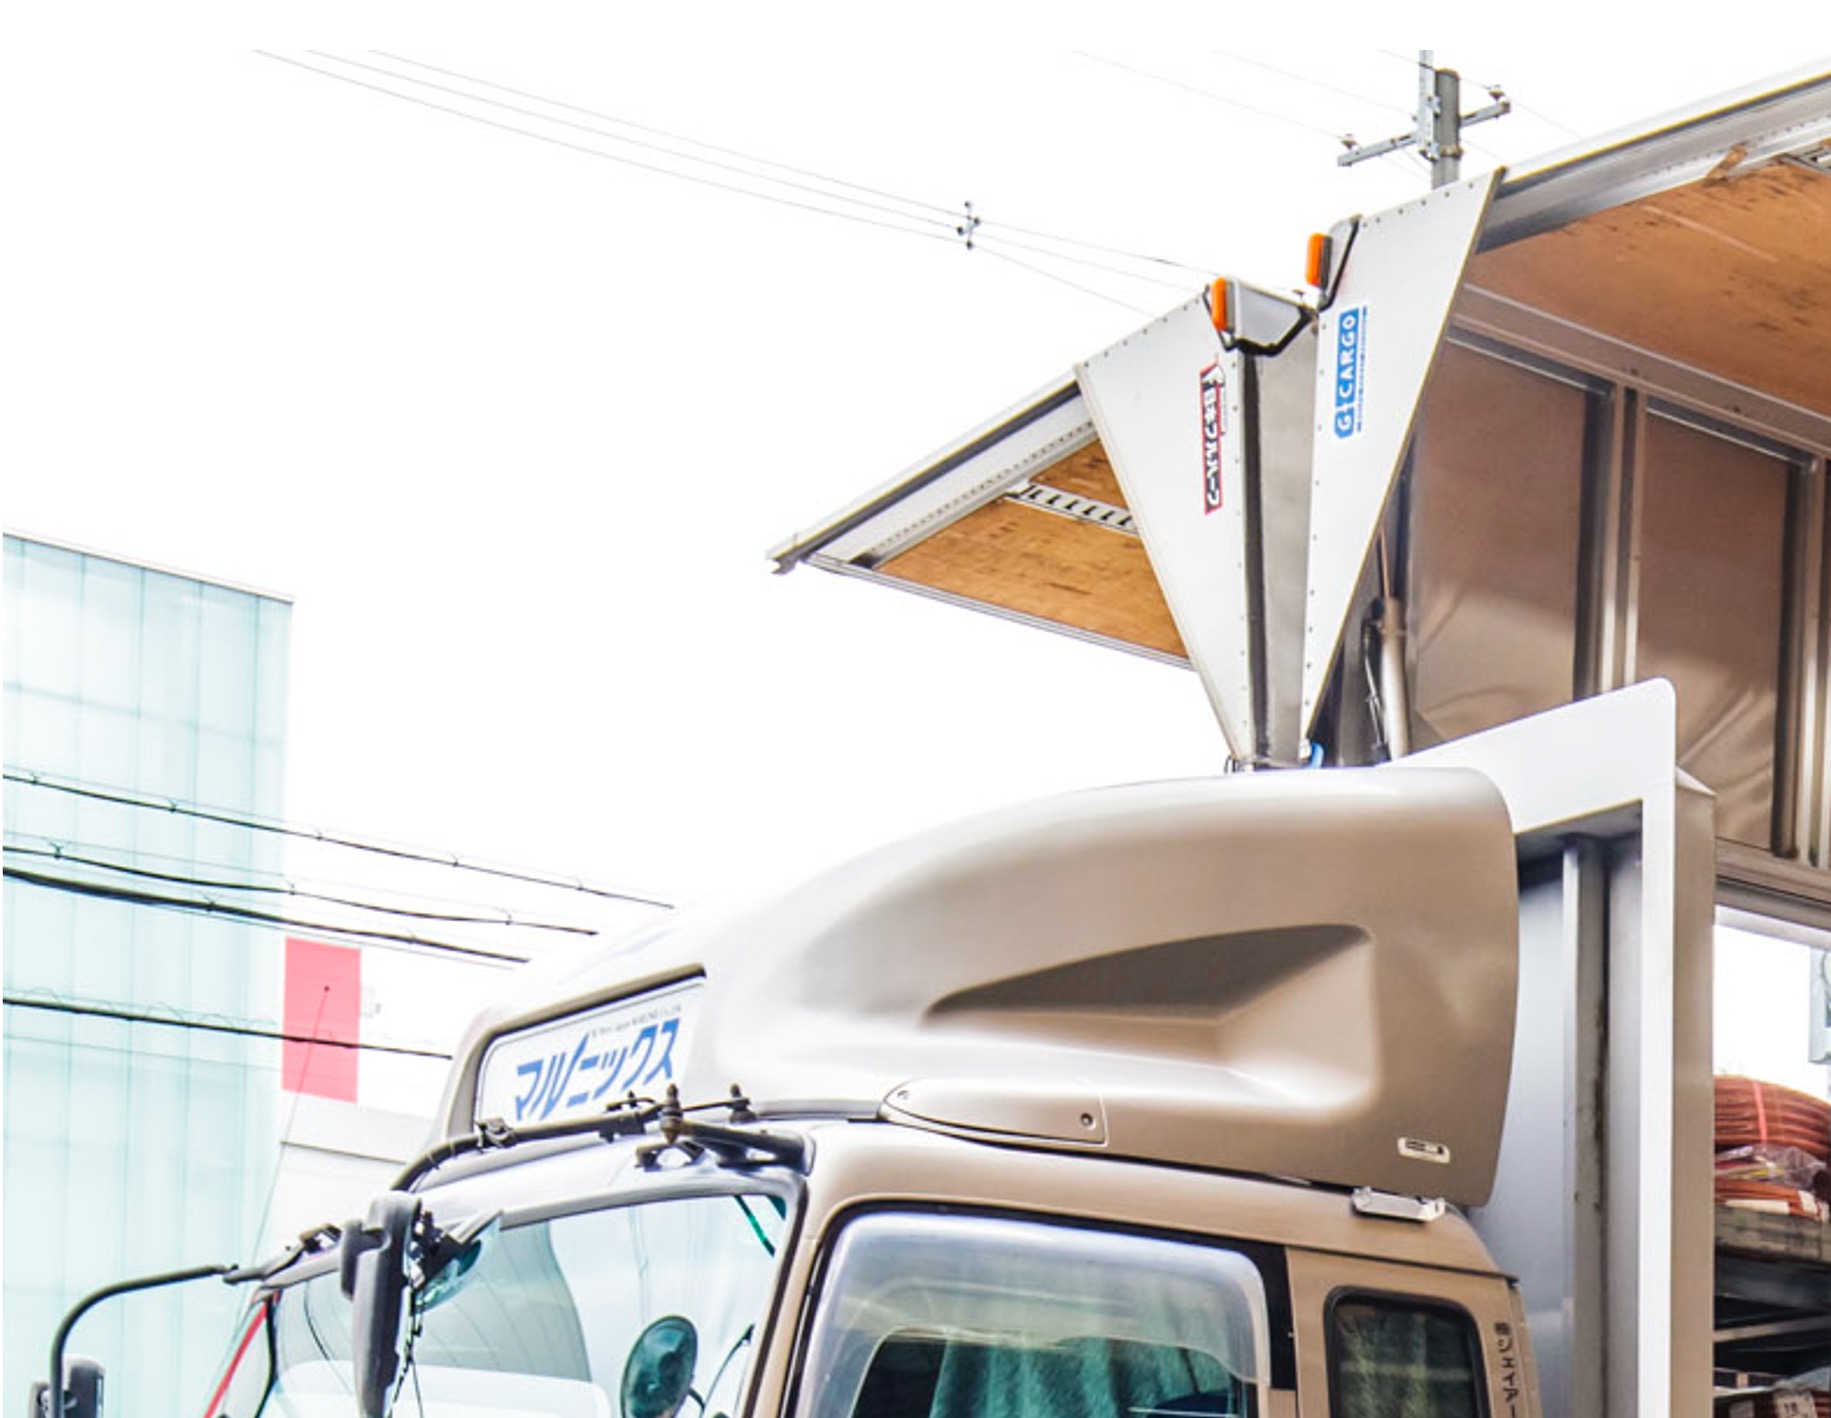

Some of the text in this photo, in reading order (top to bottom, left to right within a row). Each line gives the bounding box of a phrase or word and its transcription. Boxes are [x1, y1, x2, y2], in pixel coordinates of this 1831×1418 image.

[1338, 315, 1356, 398] CARGO
[514, 1018, 680, 1121] マルニックス
